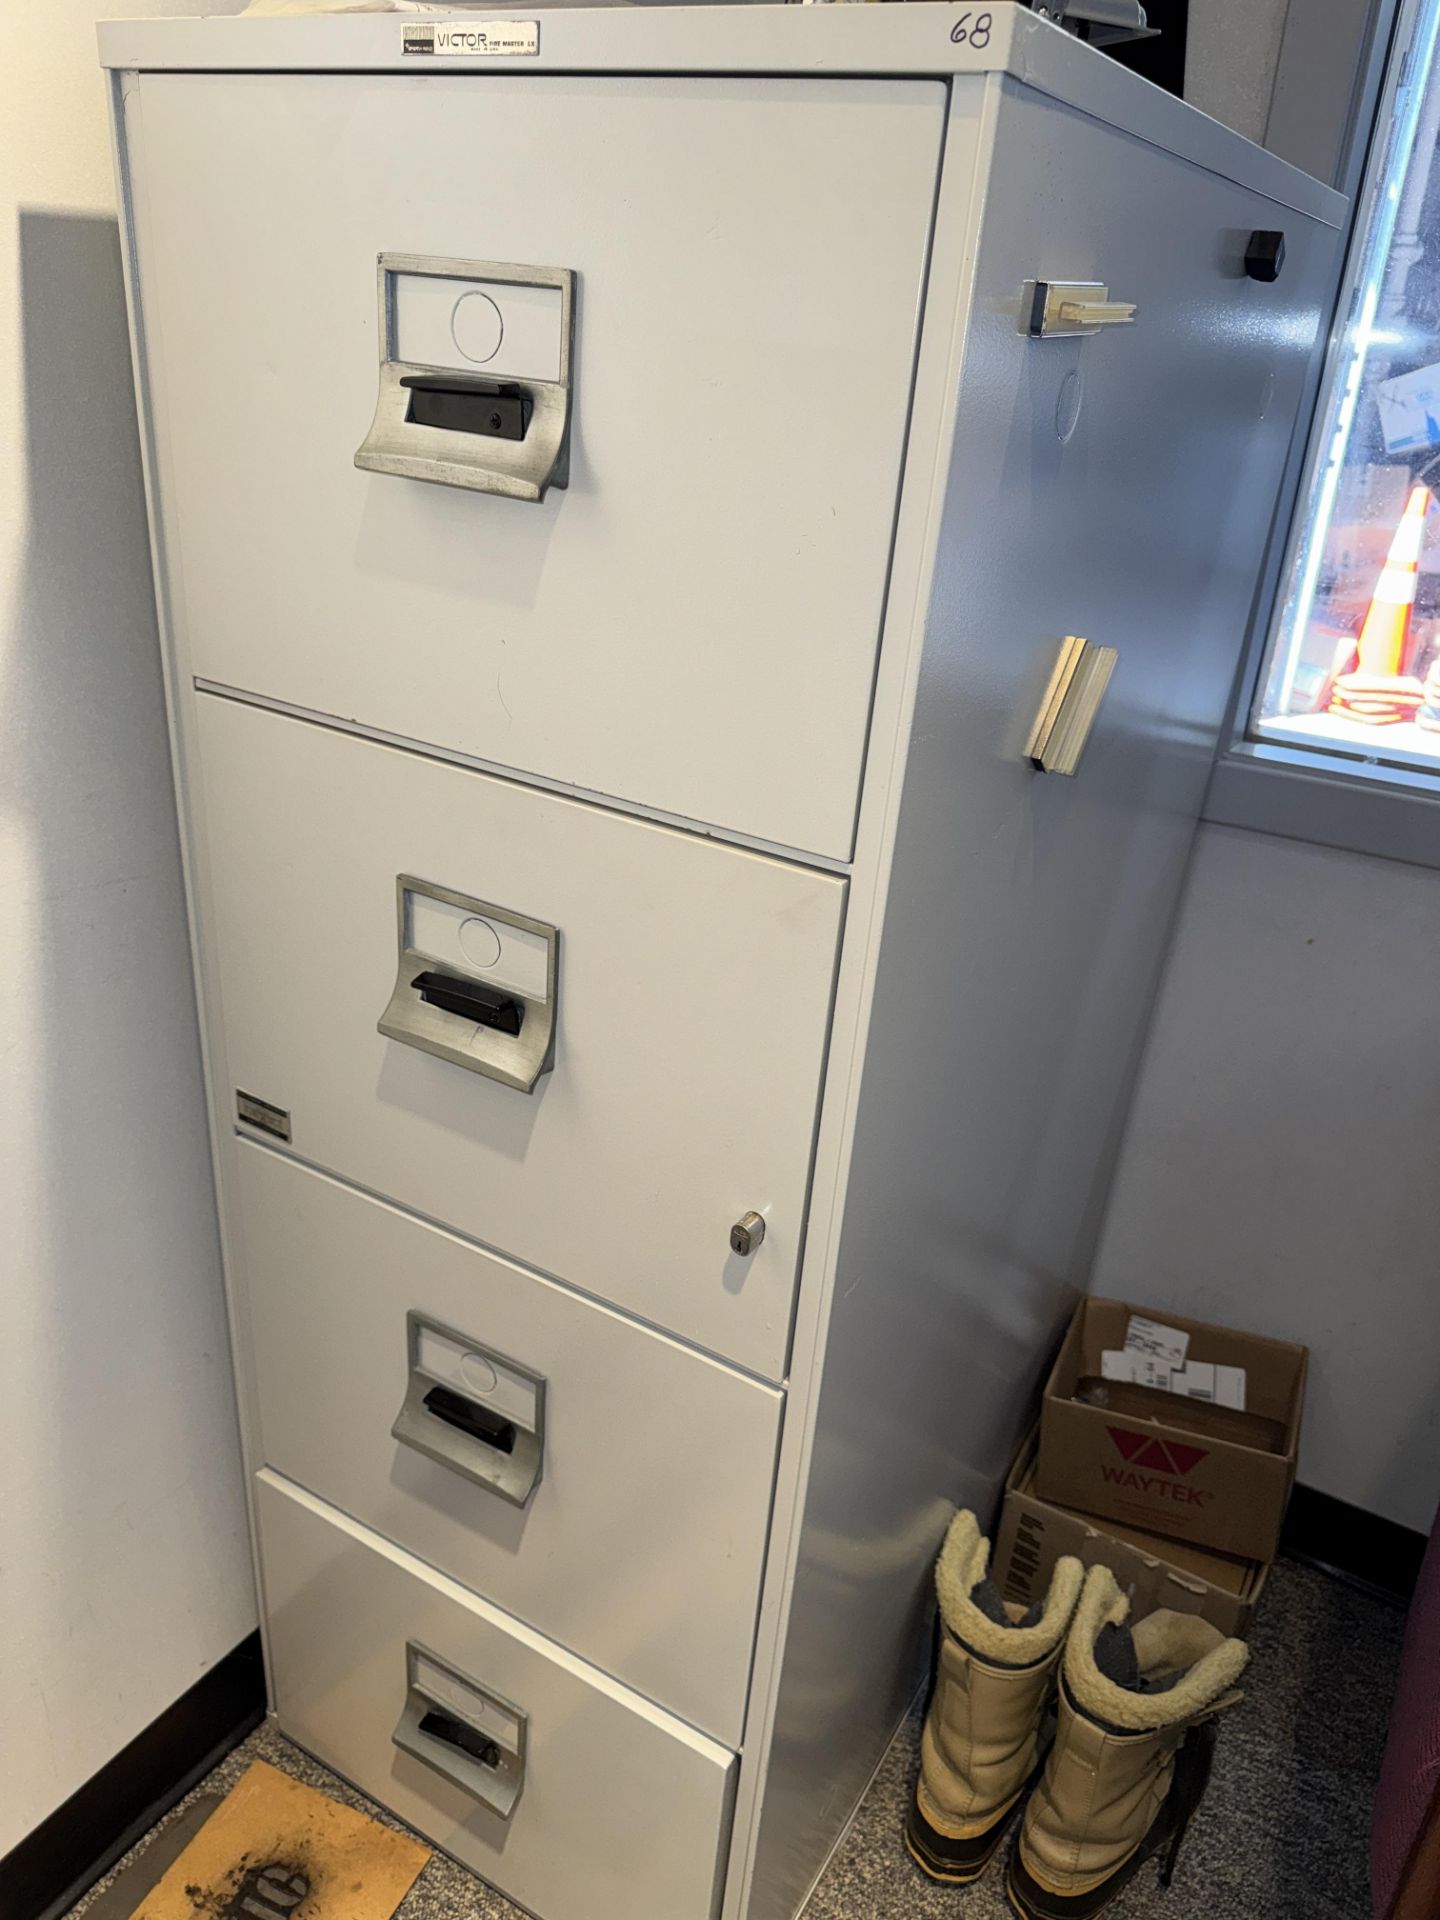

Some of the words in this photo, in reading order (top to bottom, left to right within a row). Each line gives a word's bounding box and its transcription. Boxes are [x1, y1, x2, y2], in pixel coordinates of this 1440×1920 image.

[437, 33, 488, 47] VICTOR
[950, 12, 992, 49] 68
[1101, 1464, 1205, 1508] WAYTEK
